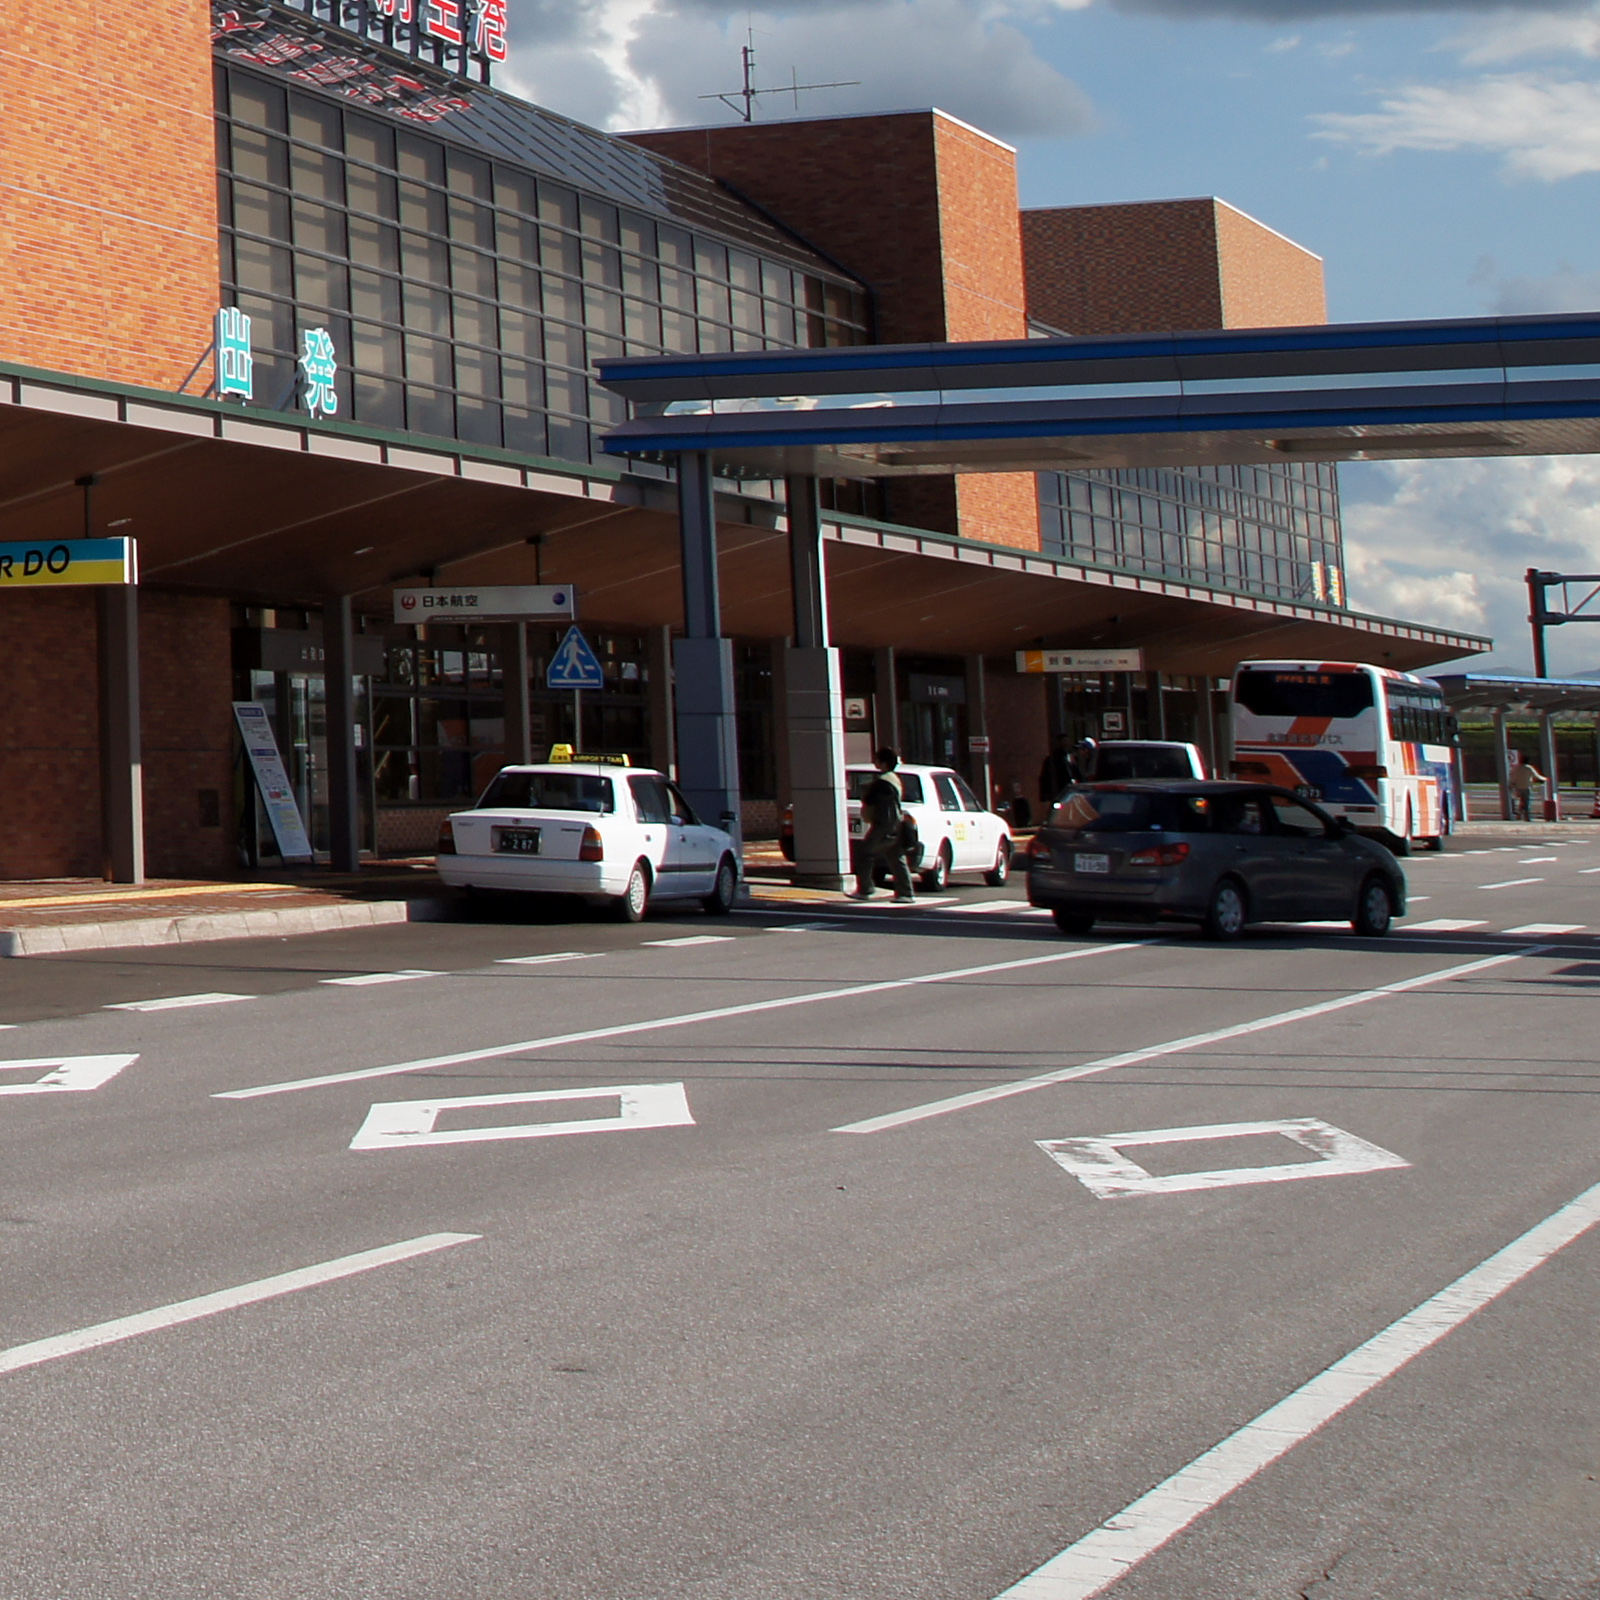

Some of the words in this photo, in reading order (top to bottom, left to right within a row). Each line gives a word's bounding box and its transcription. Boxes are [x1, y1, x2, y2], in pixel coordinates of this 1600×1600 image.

[219, 306, 338, 415] 出発
[23, 544, 71, 577] DO
[422, 594, 478, 608] 日本航空
[573, 754, 605, 763] AIRPORT
[606, 755, 622, 764] TAXI
